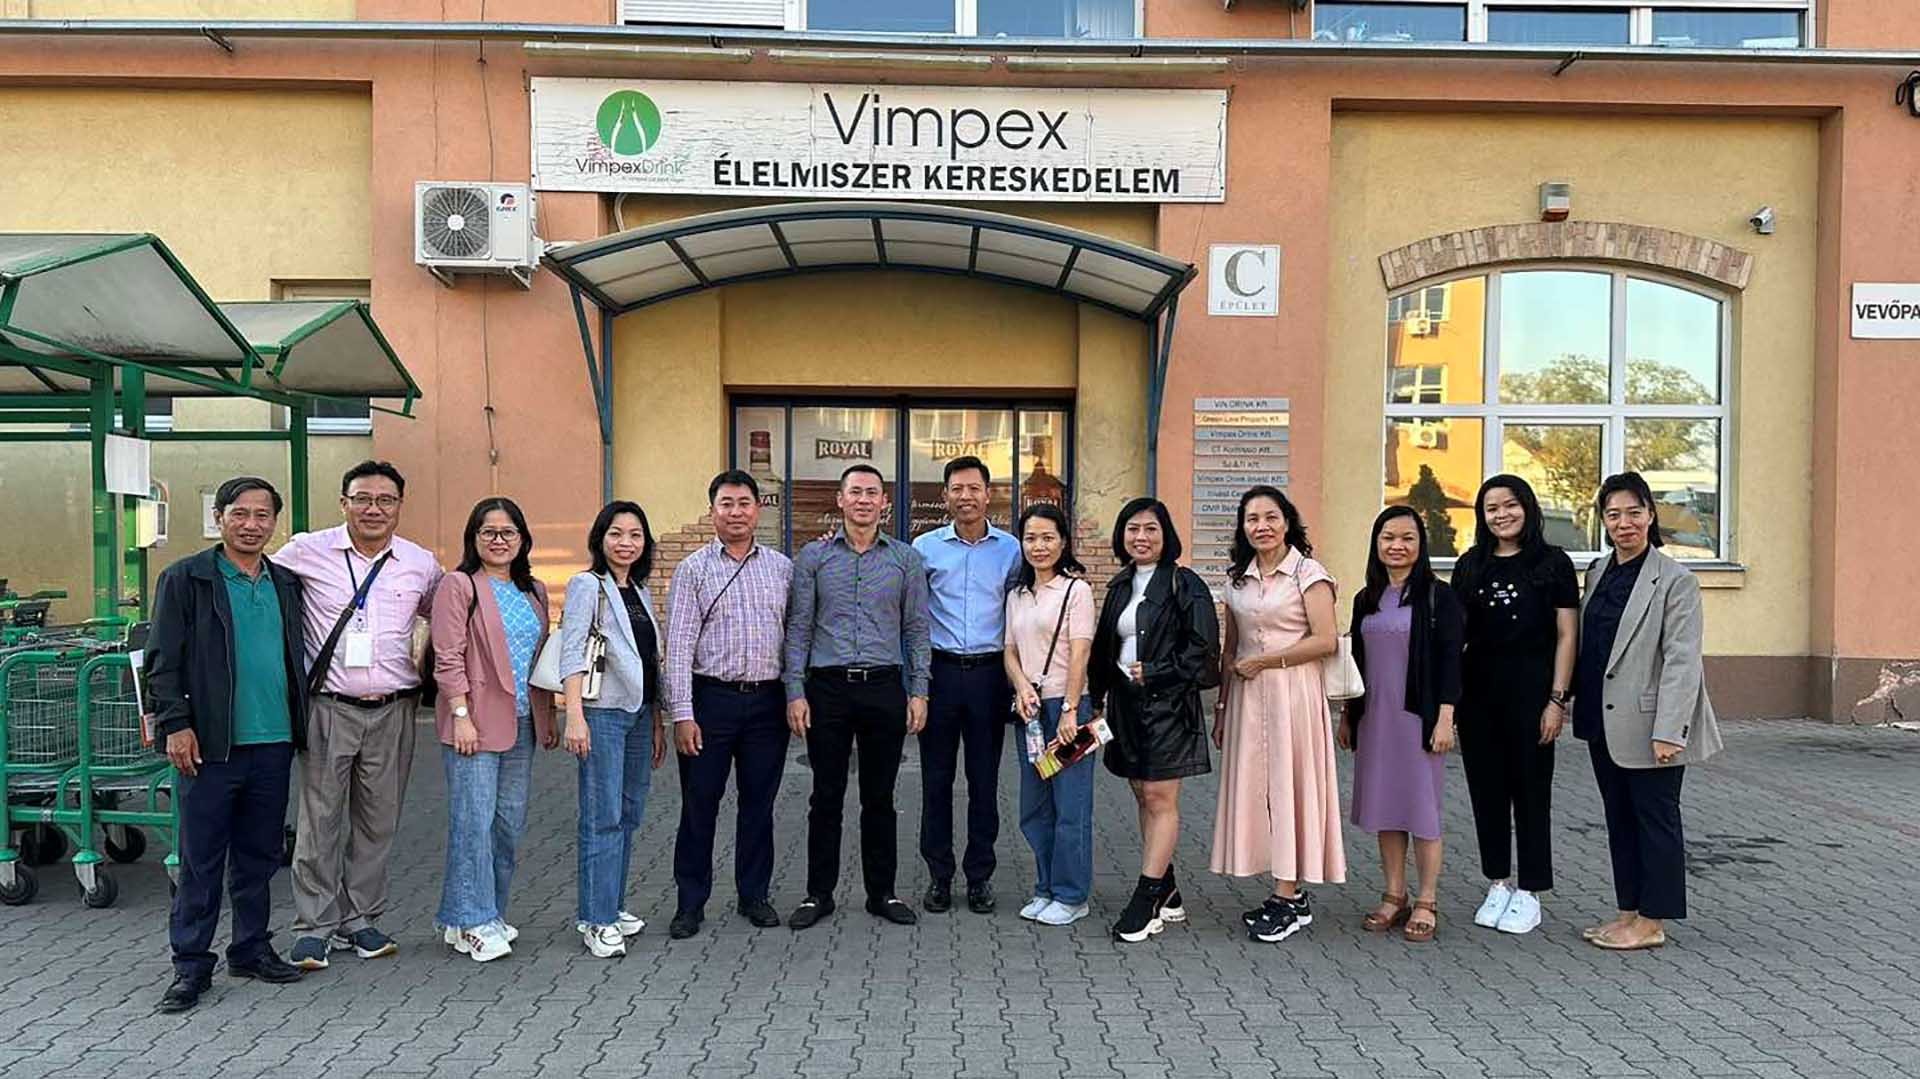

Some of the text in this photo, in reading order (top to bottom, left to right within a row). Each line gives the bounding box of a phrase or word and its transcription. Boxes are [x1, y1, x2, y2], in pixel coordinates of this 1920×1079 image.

[823, 92, 1069, 160] Vimpex
[575, 157, 684, 176] VimpexDrink
[713, 152, 1181, 194] ÉLELMISZER KERESKEDELEM
[1224, 249, 1266, 297] C
[818, 441, 869, 457] ROYAL
[758, 495, 778, 506] YAL
